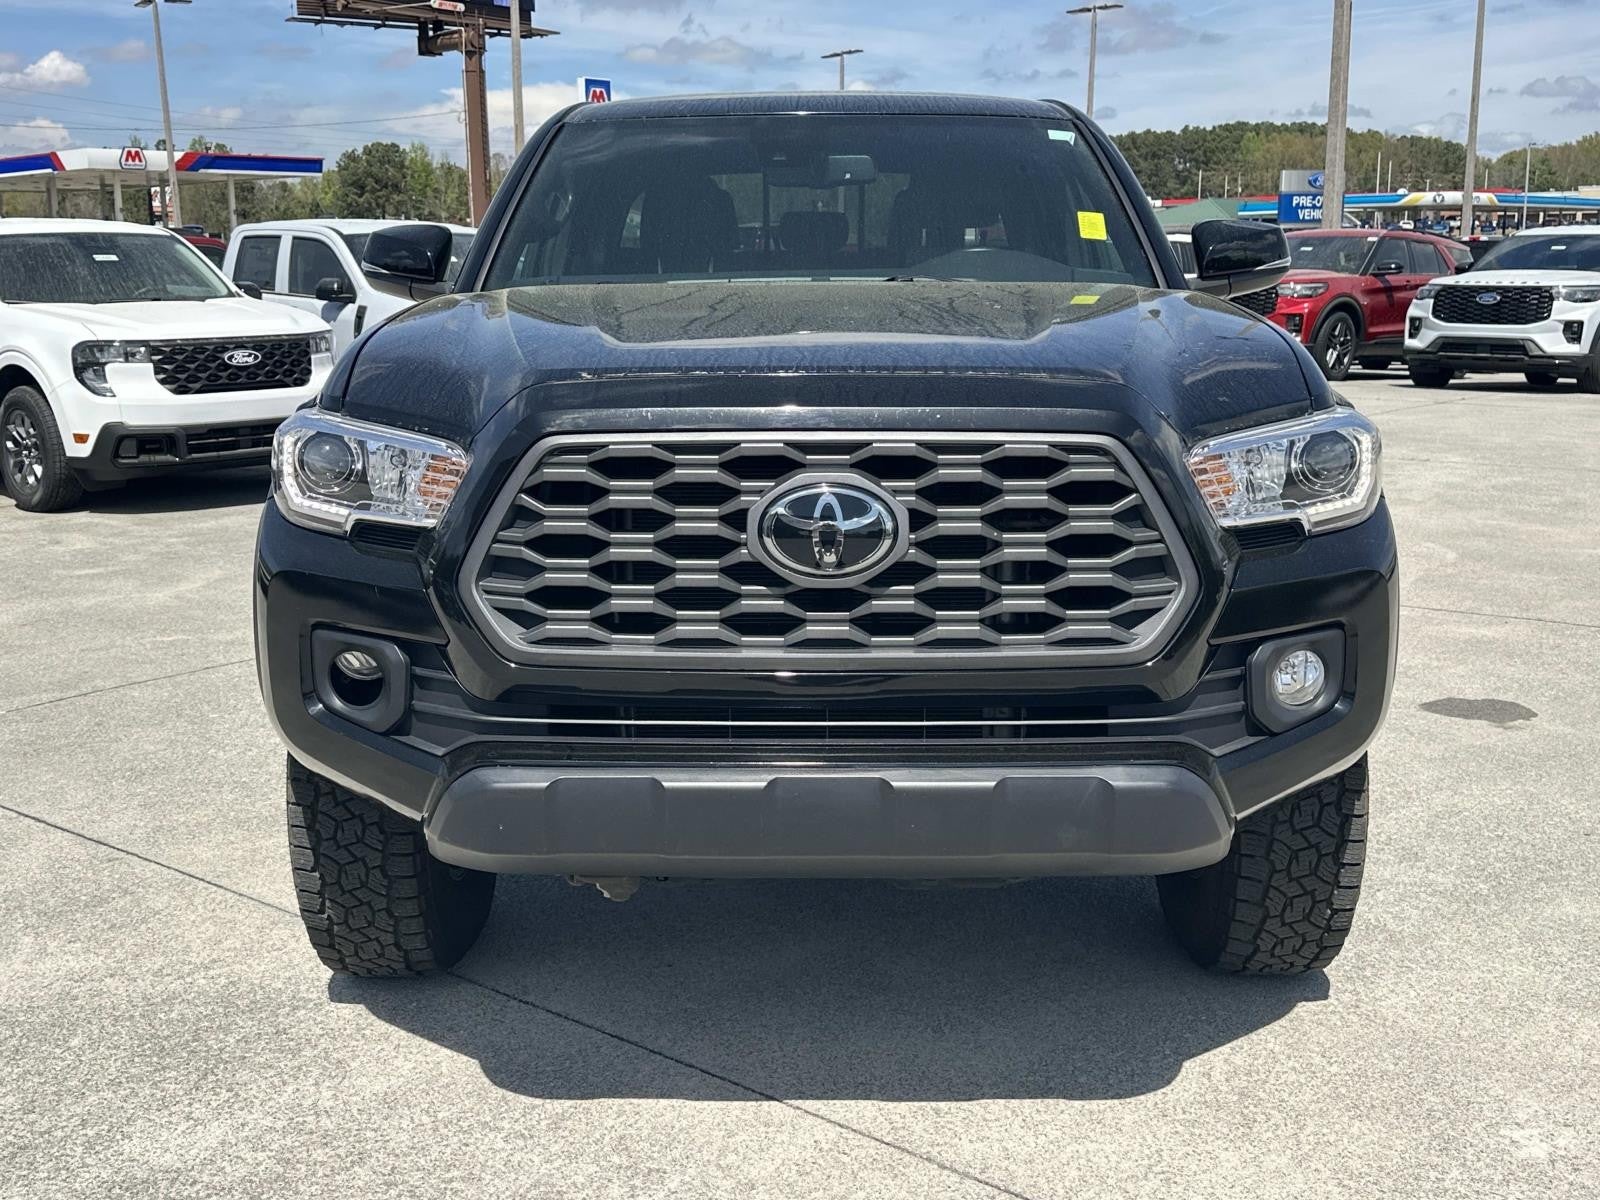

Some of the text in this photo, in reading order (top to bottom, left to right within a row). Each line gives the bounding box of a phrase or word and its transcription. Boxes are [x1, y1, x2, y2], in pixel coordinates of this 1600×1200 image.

[591, 90, 606, 103] M
[125, 150, 143, 163] M
[1292, 195, 1322, 207] PRE-O
[1298, 209, 1323, 220] VEHIC
[231, 352, 255, 363] Ford
